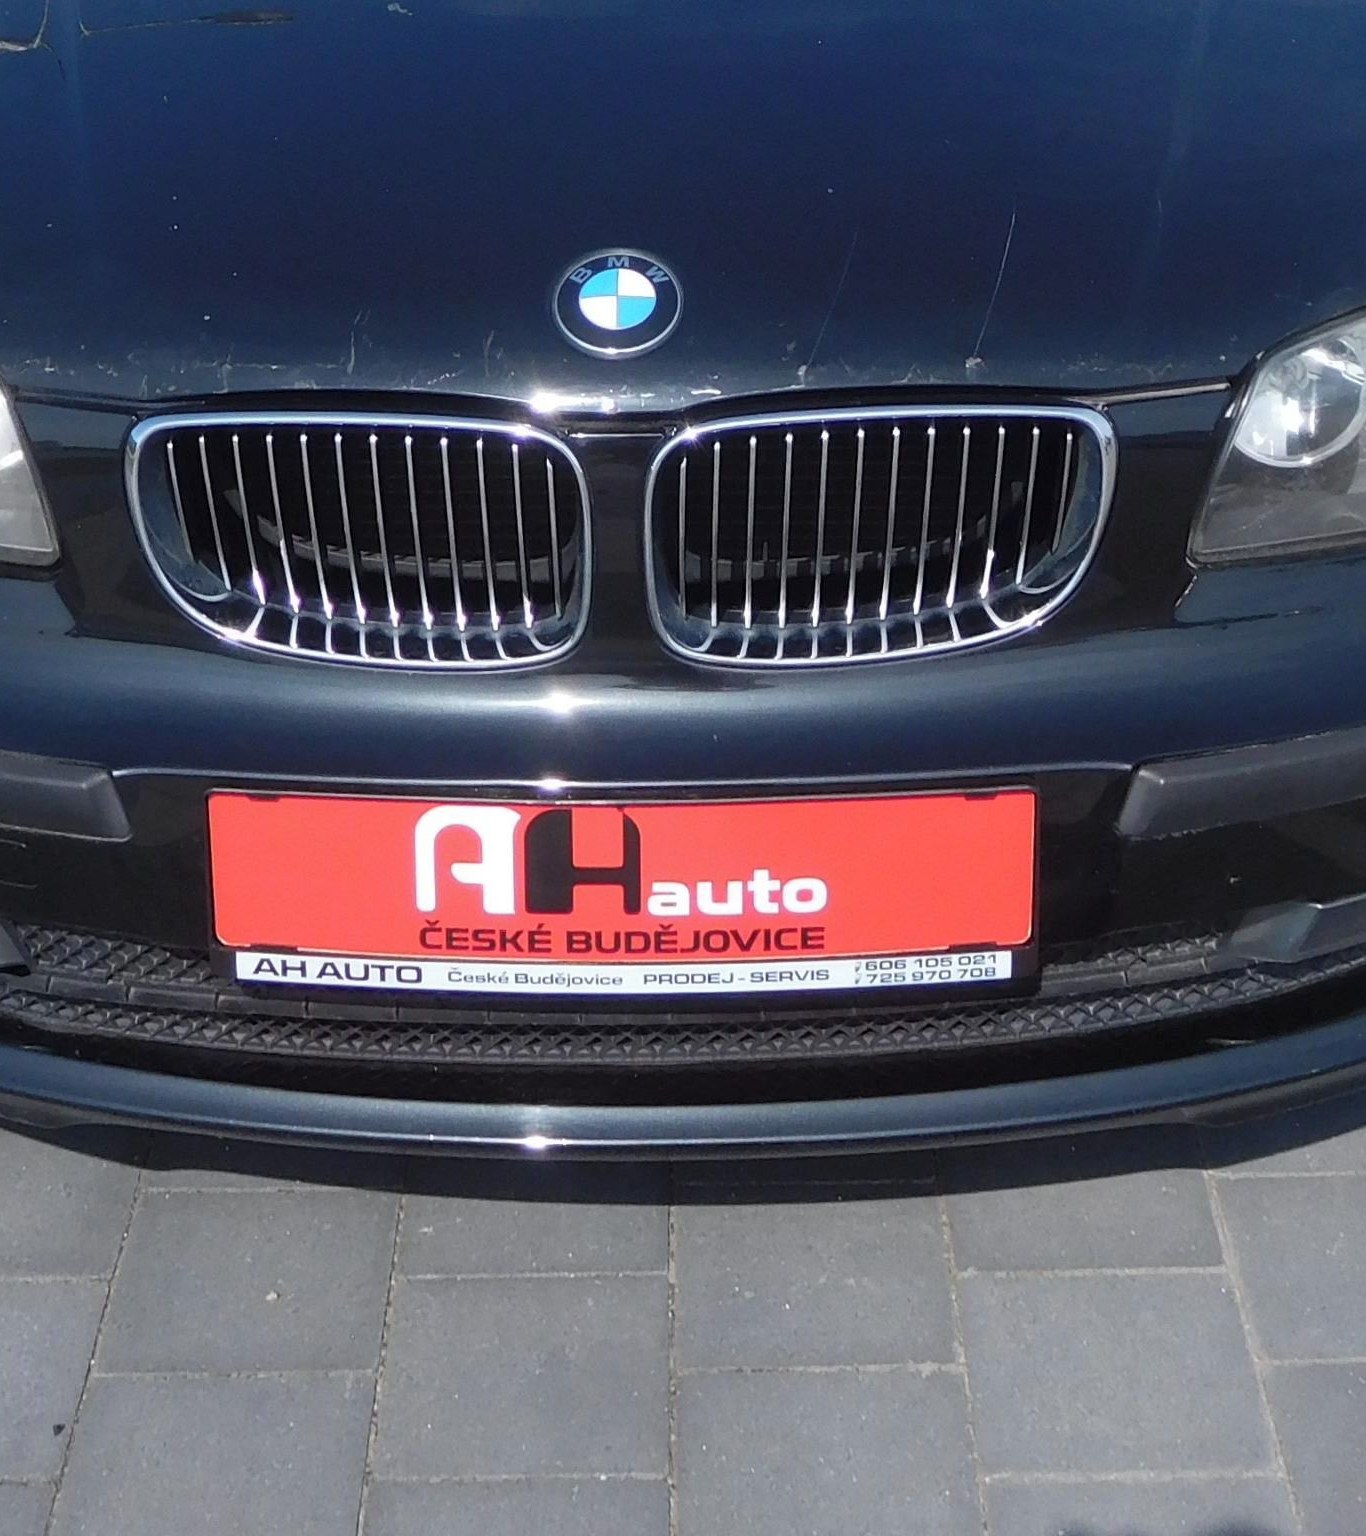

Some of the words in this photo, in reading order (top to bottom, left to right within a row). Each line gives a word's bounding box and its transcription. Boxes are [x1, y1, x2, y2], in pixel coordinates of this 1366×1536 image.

[569, 256, 670, 285] BMW
[419, 919, 552, 953] ČESKÉ
[566, 923, 825, 954] BUDĚJOVICE
[253, 957, 307, 978] AH
[316, 961, 423, 984] AUTO
[865, 959, 907, 972] 606
[913, 957, 953, 969] 105
[958, 954, 997, 966] 021
[447, 967, 510, 984] České
[514, 971, 624, 988] Budějovice
[643, 972, 734, 985] PRODEJ
[749, 969, 830, 983] SERVIS
[866, 972, 906, 985] 725
[911, 969, 951, 982] 970
[958, 967, 996, 979] 708
